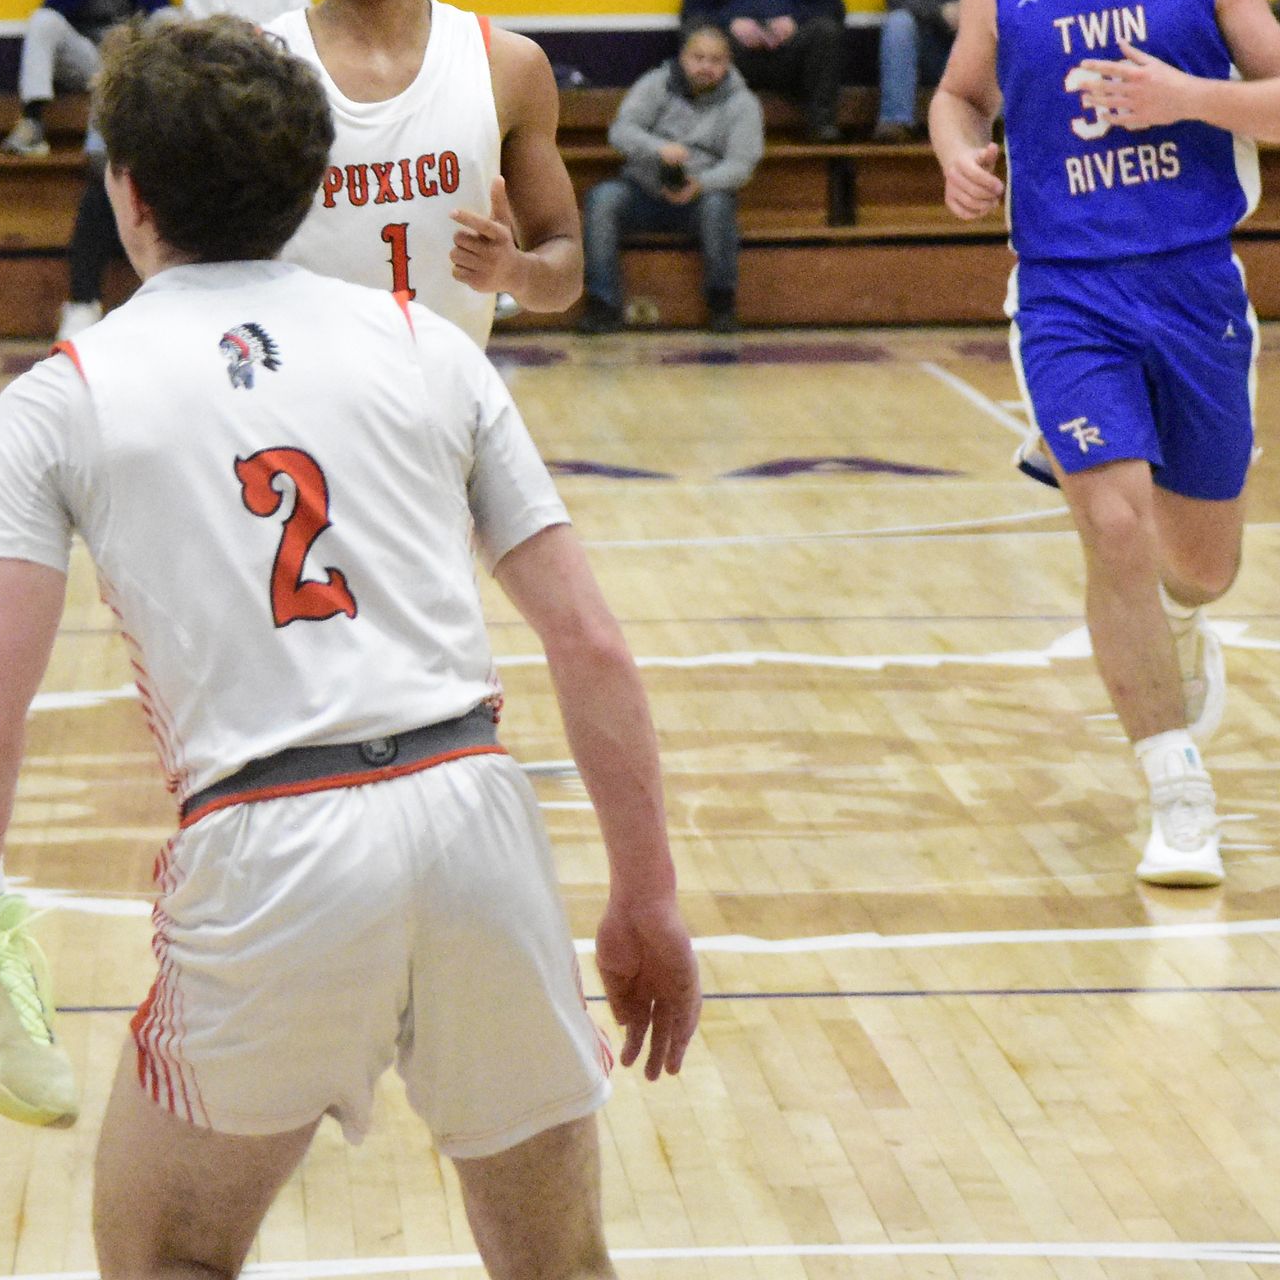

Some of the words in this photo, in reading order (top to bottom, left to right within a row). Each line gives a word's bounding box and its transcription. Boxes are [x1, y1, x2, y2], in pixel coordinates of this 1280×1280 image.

[1053, 3, 1147, 54] TWIN
[321, 150, 461, 209] PUXICO
[1064, 140, 1181, 196] RIVERS
[380, 222, 417, 301] 1
[233, 446, 358, 629] 2
